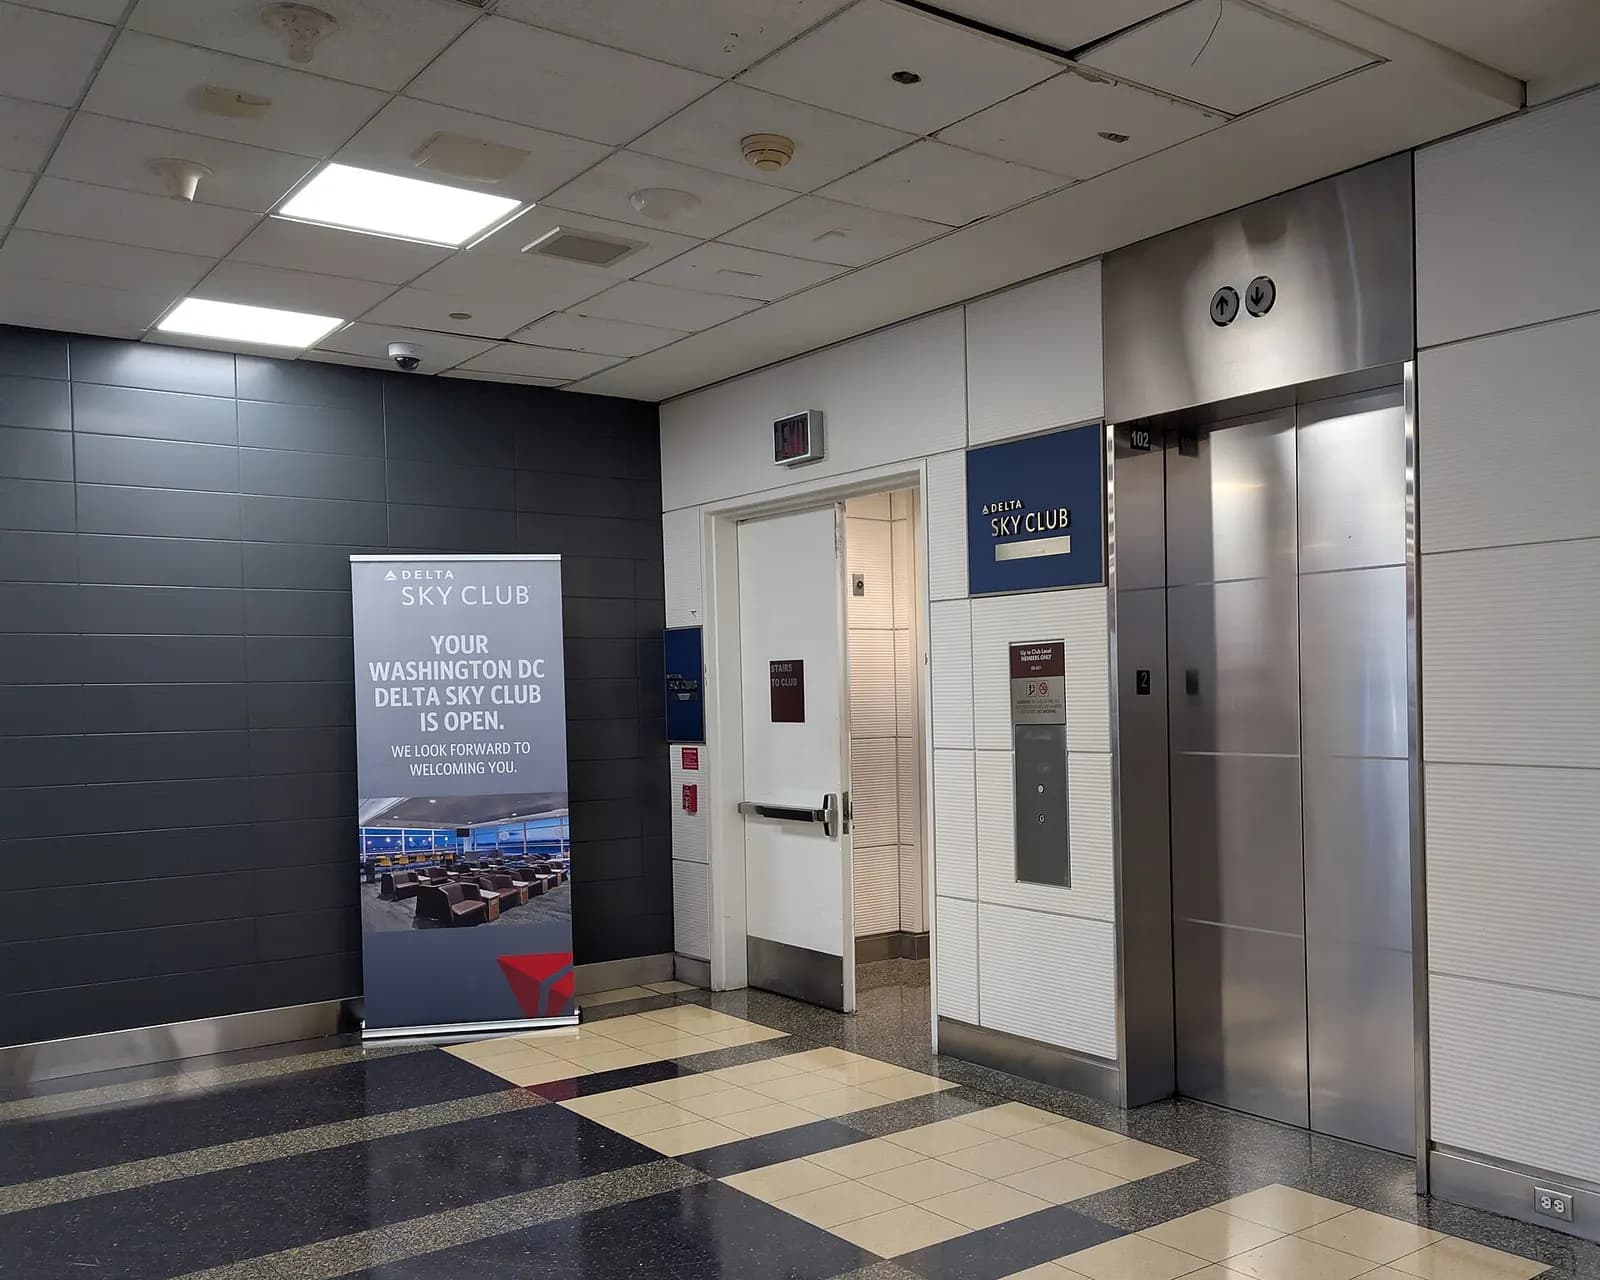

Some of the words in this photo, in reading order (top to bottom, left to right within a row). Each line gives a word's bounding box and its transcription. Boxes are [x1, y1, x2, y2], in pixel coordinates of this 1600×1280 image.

[1131, 429, 1149, 447] 102
[991, 499, 1022, 513] DELTA
[991, 515, 1021, 537] SKY
[1025, 508, 1069, 533] CLUB
[401, 569, 454, 580] DELTA
[401, 585, 453, 606] SKY
[461, 585, 530, 605] CLUB
[430, 634, 489, 655] YOUR
[368, 659, 512, 681] WASHINGTON
[518, 659, 545, 679] DC
[771, 664, 792, 673] STAIRS
[771, 678, 780, 688] TO
[780, 677, 798, 687] CLUB
[1141, 672, 1148, 687] 2
[374, 686, 440, 707] DELTA
[445, 685, 486, 706] SKY
[490, 684, 542, 704] CLUB
[420, 711, 439, 732] IS
[444, 711, 505, 731] OPEN.
[391, 744, 411, 758] WE
[414, 743, 448, 757] LOOK
[450, 742, 511, 756] FORWARD
[514, 741, 531, 755] TO
[409, 762, 485, 777] WELCOMING
[488, 761, 518, 775] YOU.
